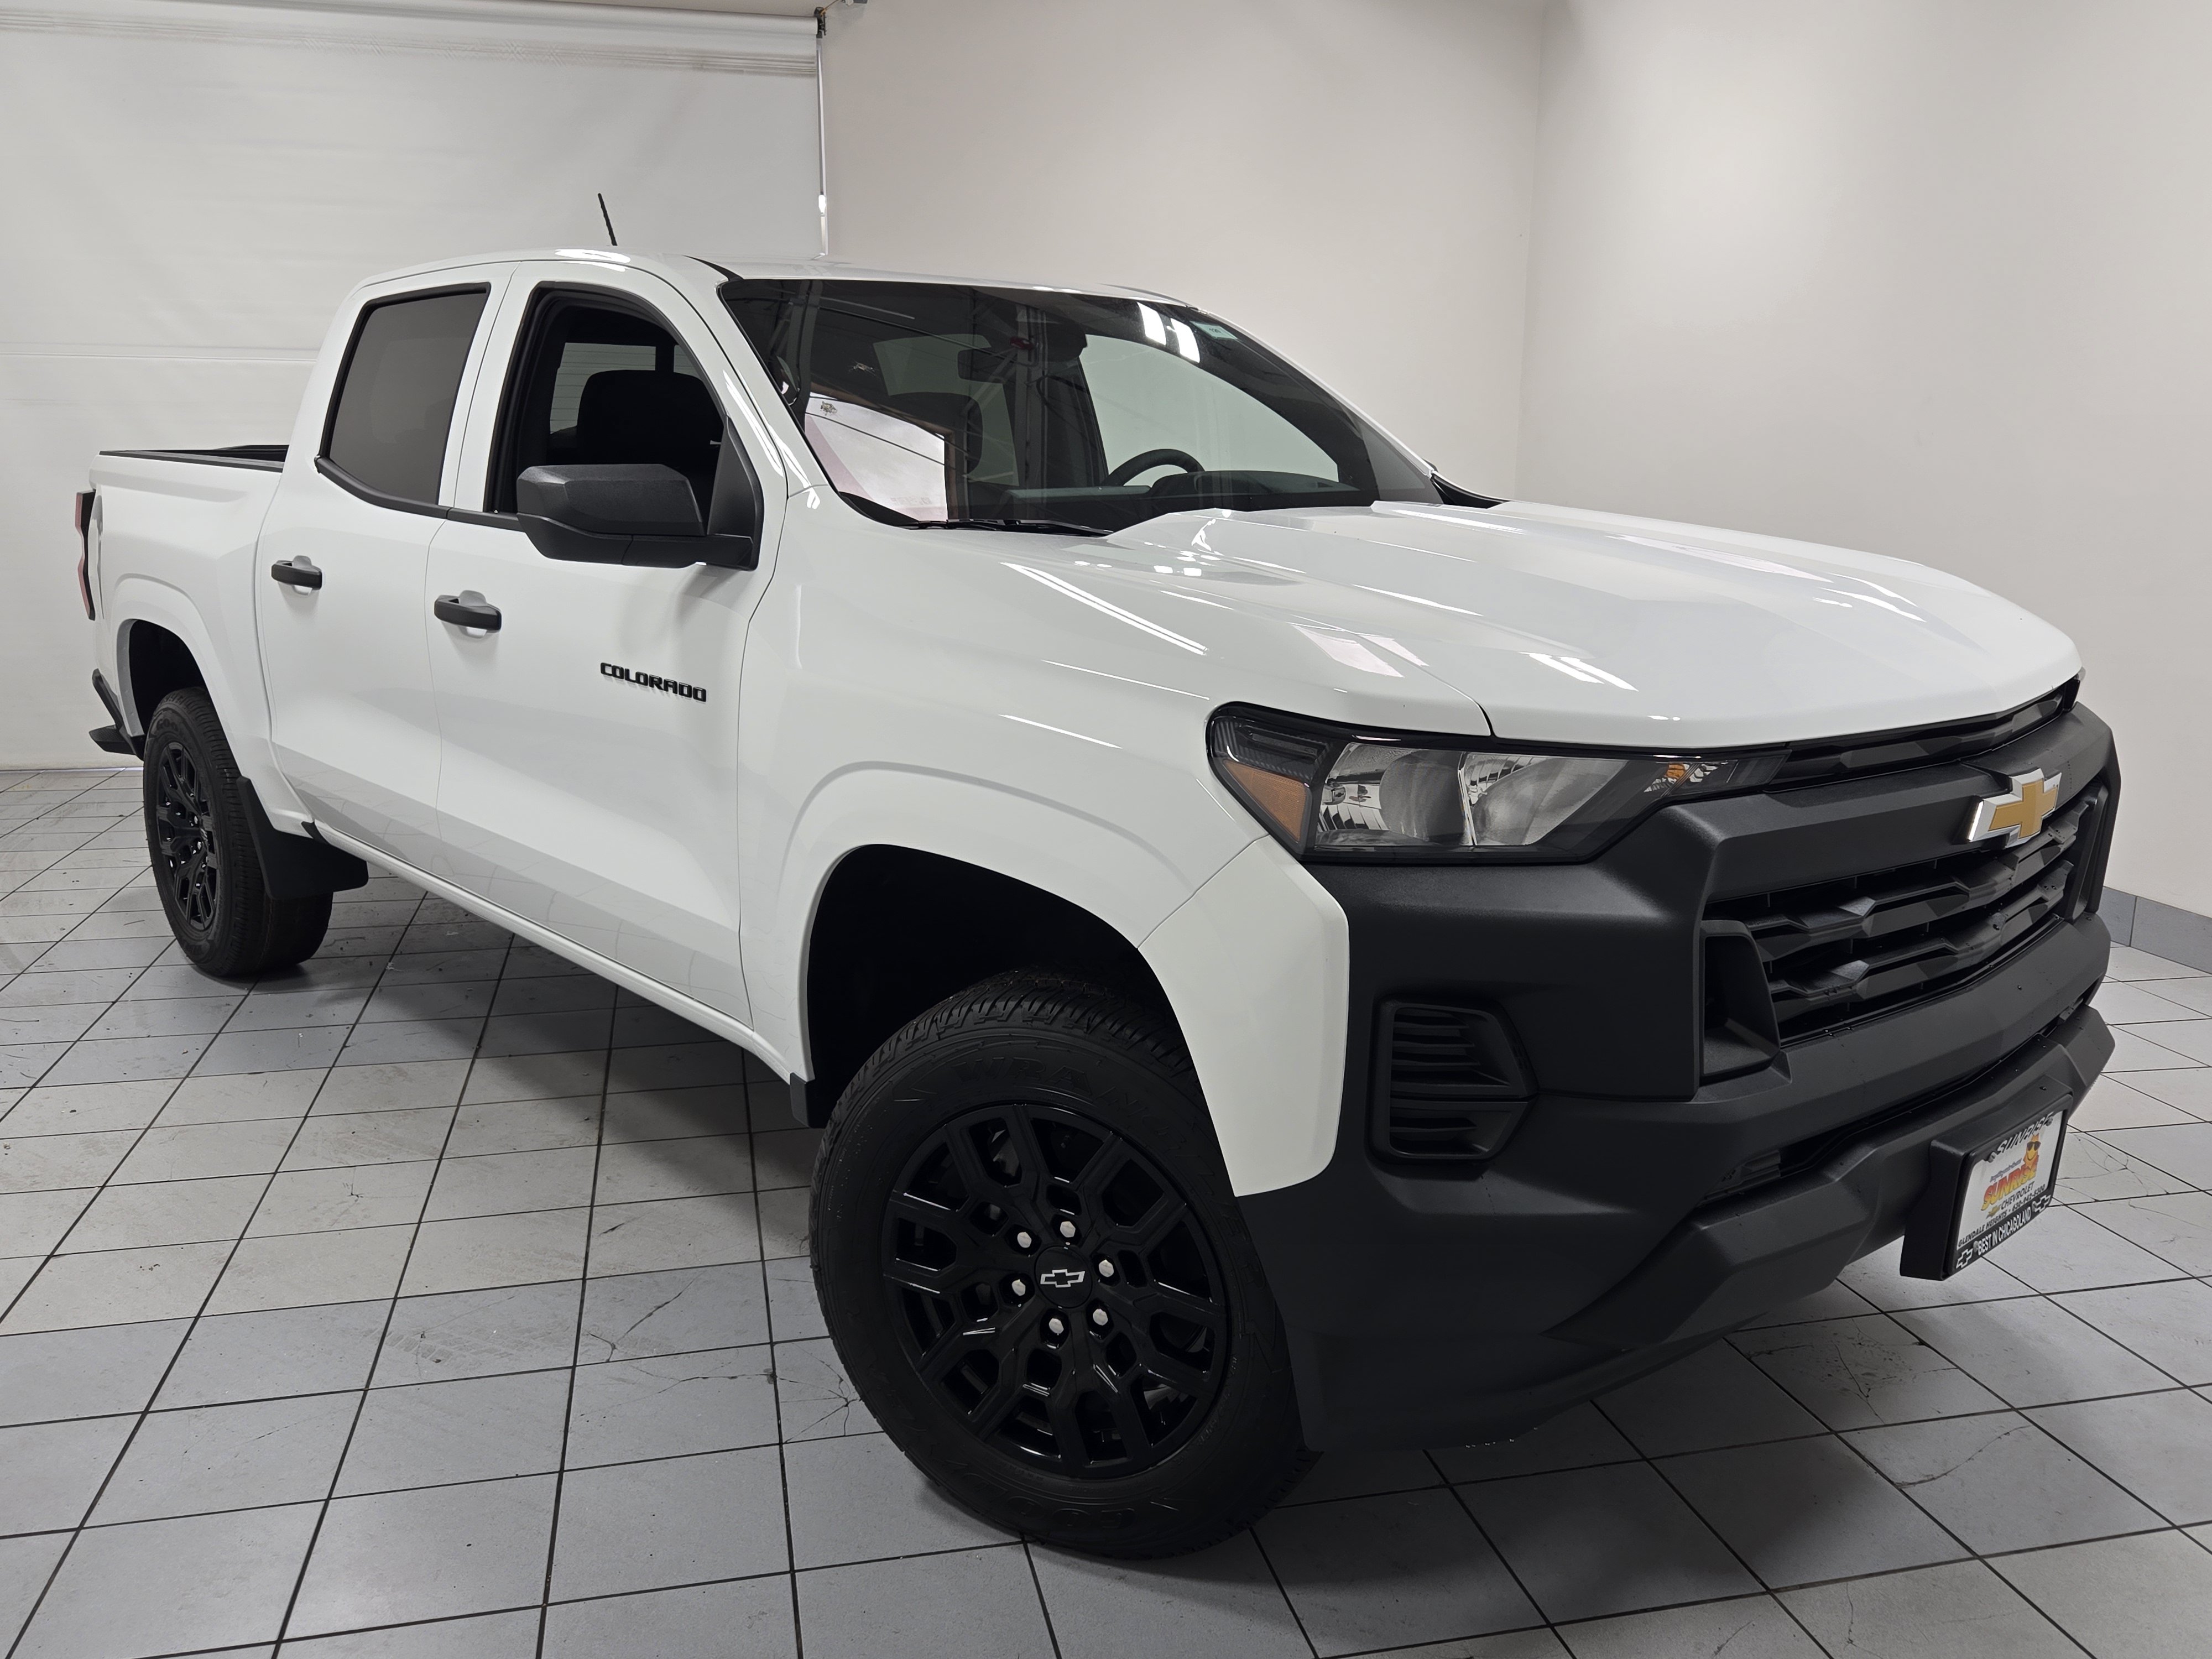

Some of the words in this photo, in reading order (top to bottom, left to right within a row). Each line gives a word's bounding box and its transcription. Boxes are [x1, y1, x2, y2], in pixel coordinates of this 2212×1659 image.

[600, 662, 707, 702] COLORADO
[1996, 1112, 2054, 1155] SUNRISE
[1981, 1157, 2039, 1211] SUNRISE
[2000, 1181, 2035, 1210] CHEVROLET
[1958, 1224, 1985, 1248] GLENDALE
[1985, 1211, 2007, 1230] HEIGHTS
[1977, 1233, 1992, 1256] BEST
[1992, 1229, 1998, 1246] IN
[1998, 1207, 2031, 1242] CHICAGOLAND
